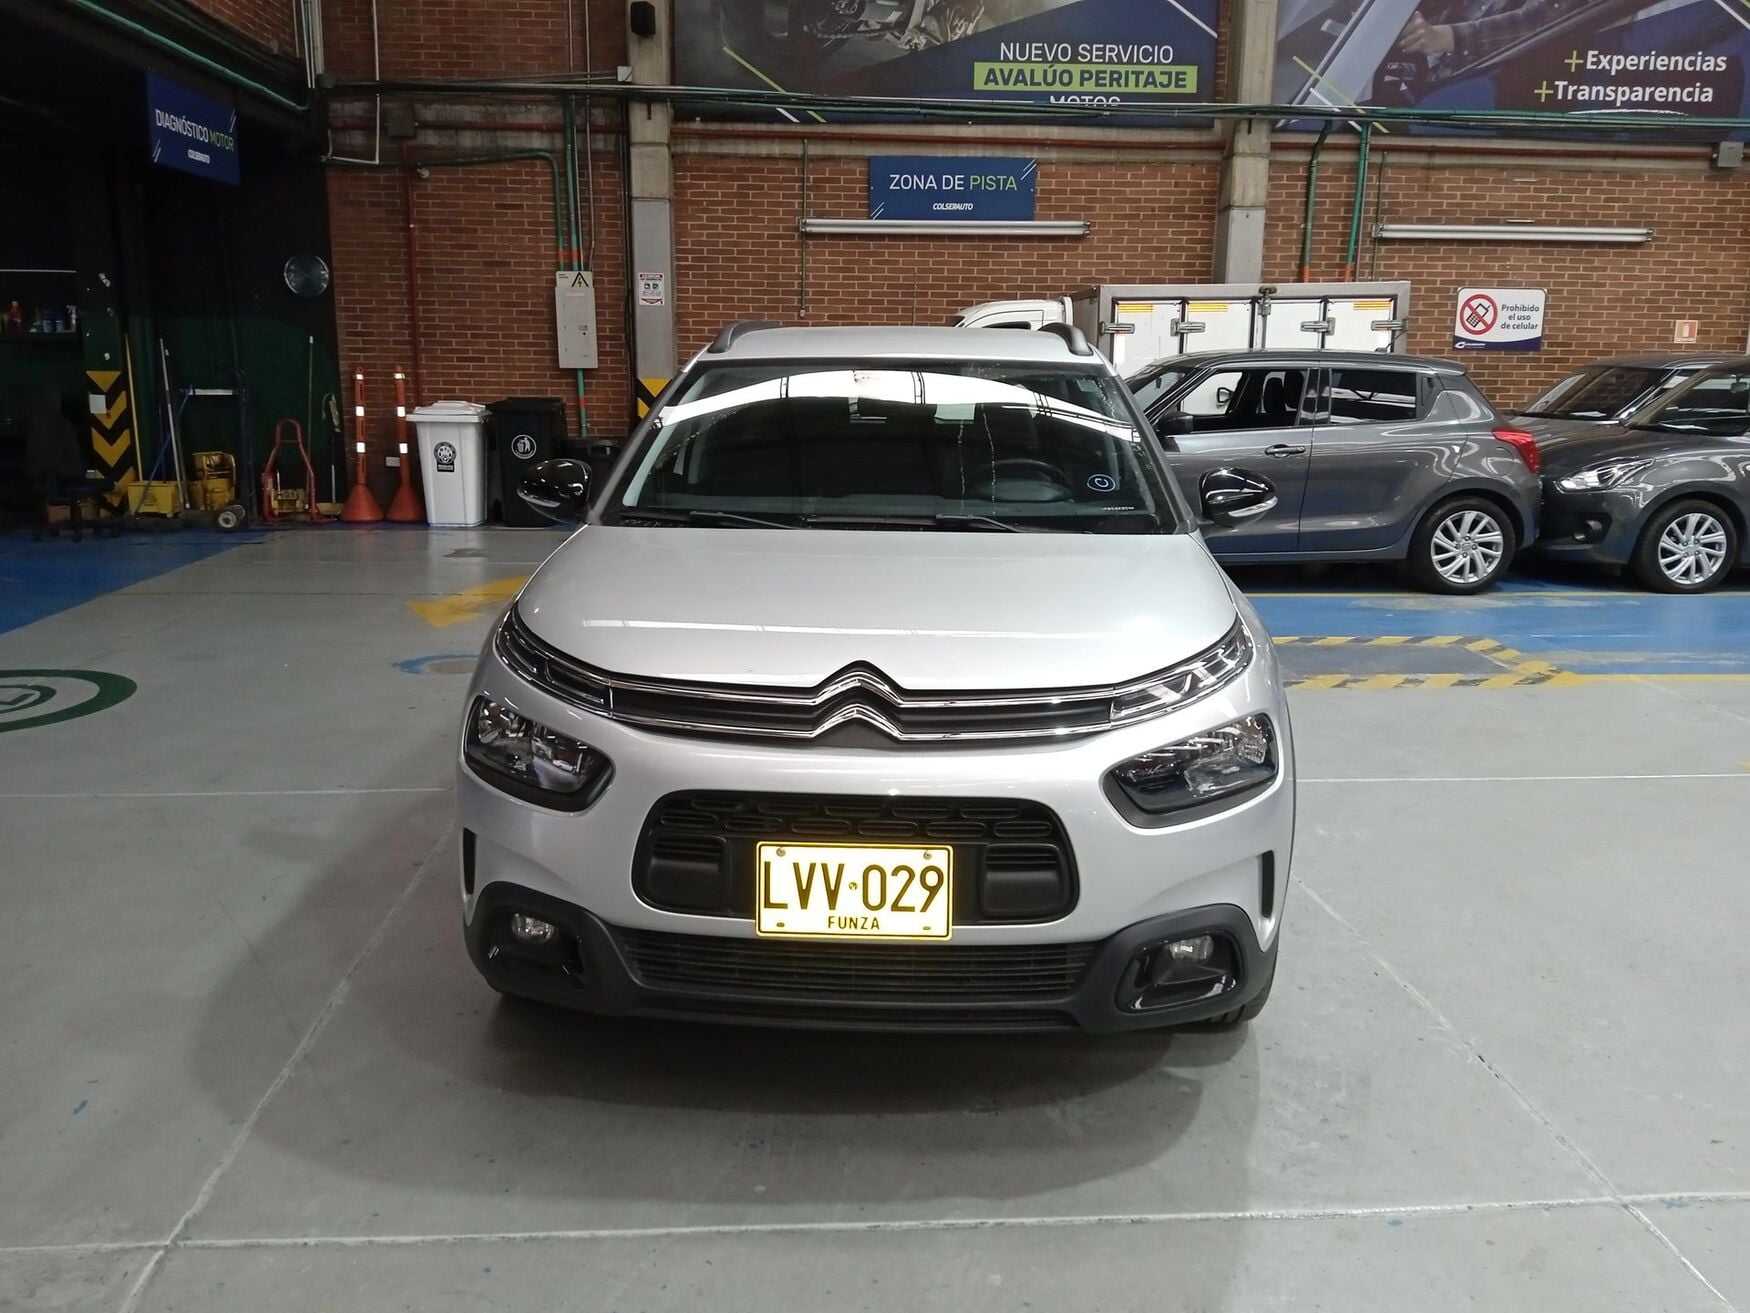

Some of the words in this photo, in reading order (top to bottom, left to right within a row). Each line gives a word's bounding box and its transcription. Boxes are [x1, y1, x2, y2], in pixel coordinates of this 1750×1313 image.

[1000, 42, 1071, 62] NUEVO
[1077, 44, 1174, 64] SERVICIO
[983, 63, 1074, 87] AVALÚO
[1079, 69, 1188, 89] PERITAJE
[155, 108, 209, 143] DIAGNÓSTICO
[209, 129, 235, 152] MOTOR
[889, 174, 938, 190] ZONA
[942, 174, 965, 190] DE
[969, 175, 1018, 191] PISTA
[932, 202, 974, 211] COLSERAUTO
[1501, 304, 1540, 312] Prohibido
[1508, 313, 1516, 321] el
[1500, 322, 1511, 330] de
[1512, 322, 1538, 330] celular
[827, 915, 880, 930] FUNZA
